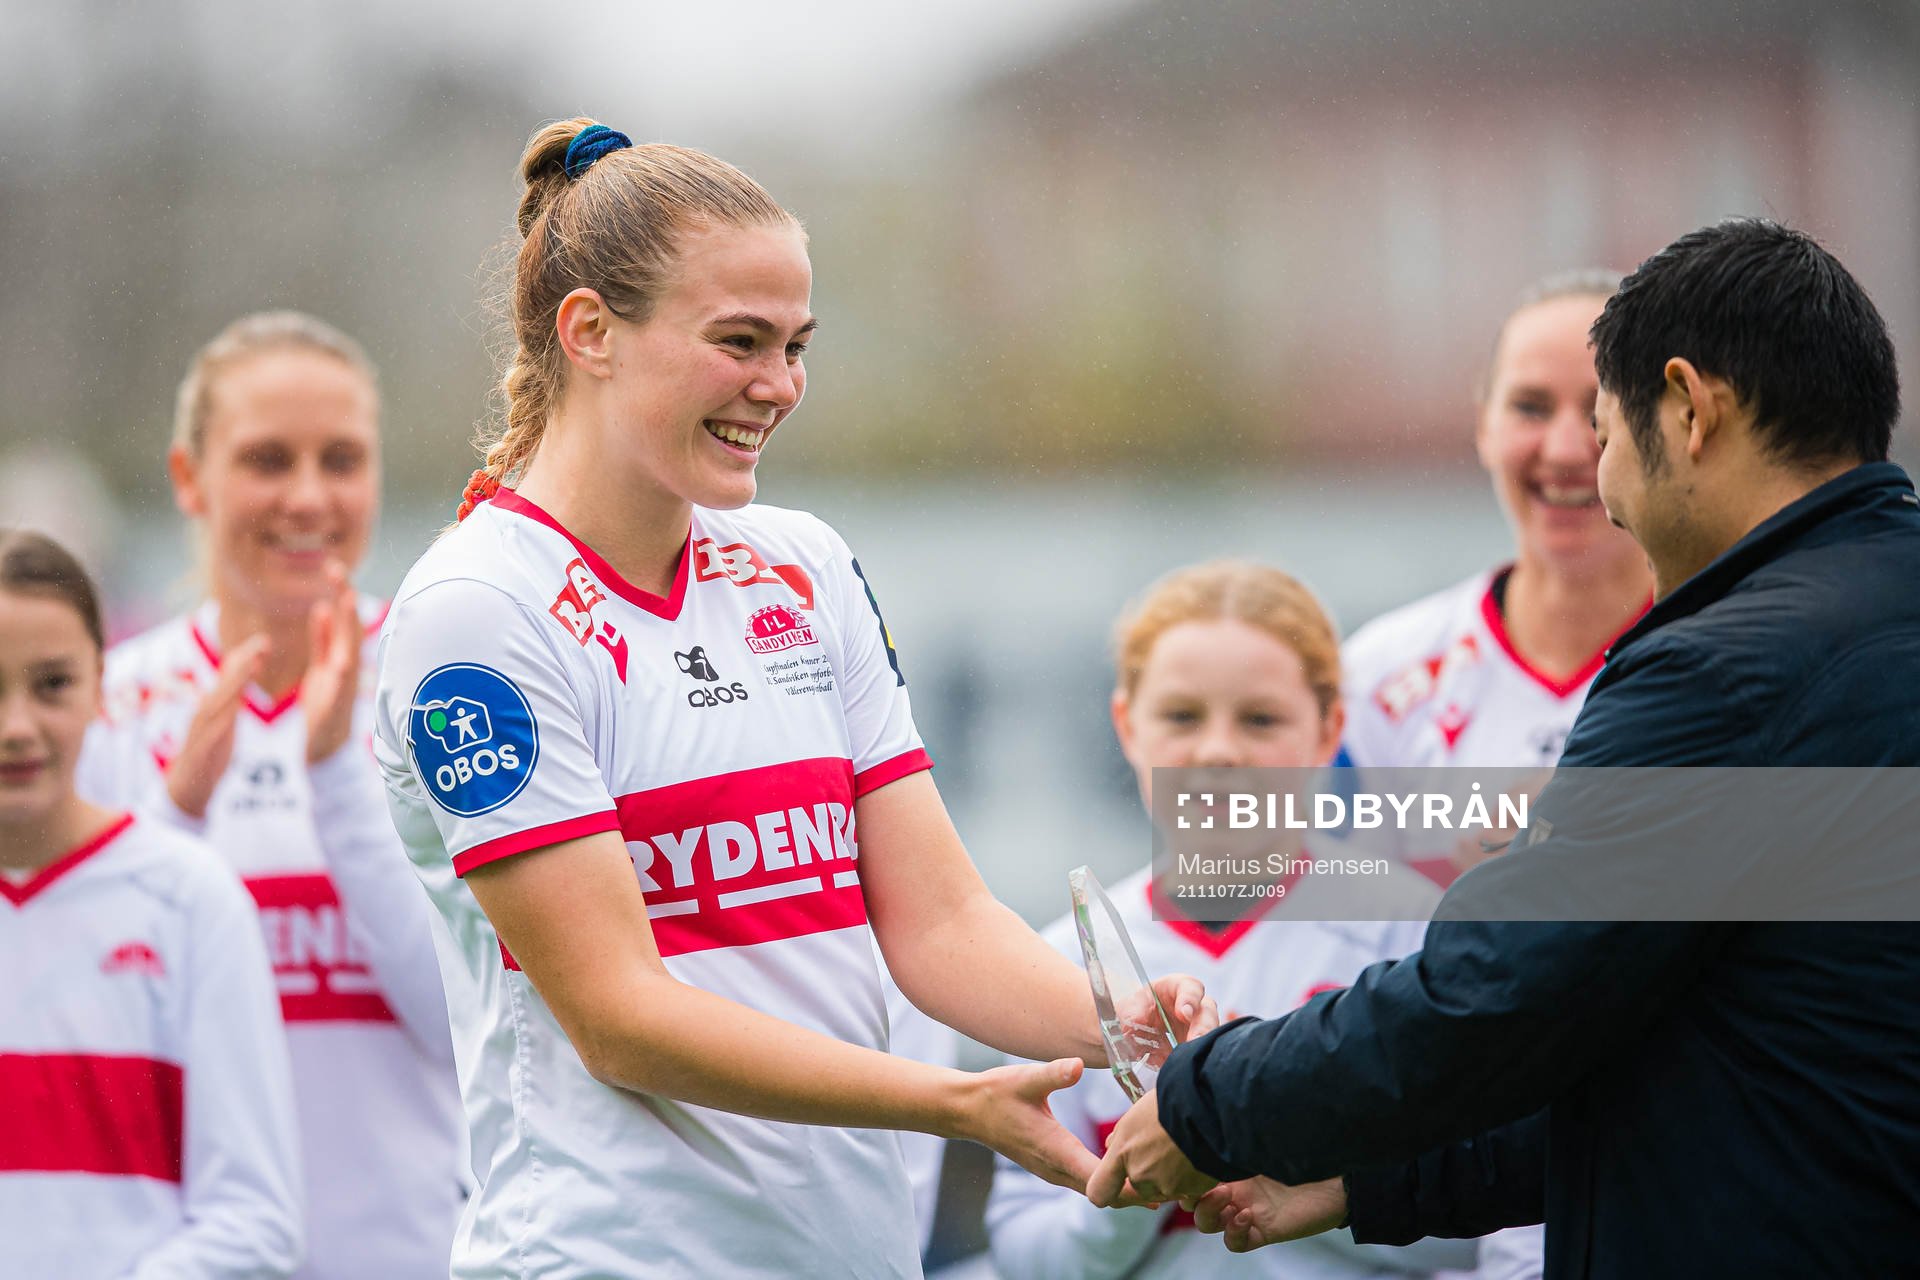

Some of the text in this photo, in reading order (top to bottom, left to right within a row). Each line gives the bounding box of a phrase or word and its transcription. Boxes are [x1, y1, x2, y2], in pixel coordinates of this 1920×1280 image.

[751, 628, 813, 651] SANDVIKEN
[773, 672, 809, 685] Sandviken
[687, 682, 749, 708] OBOS
[435, 743, 520, 793] OBOS
